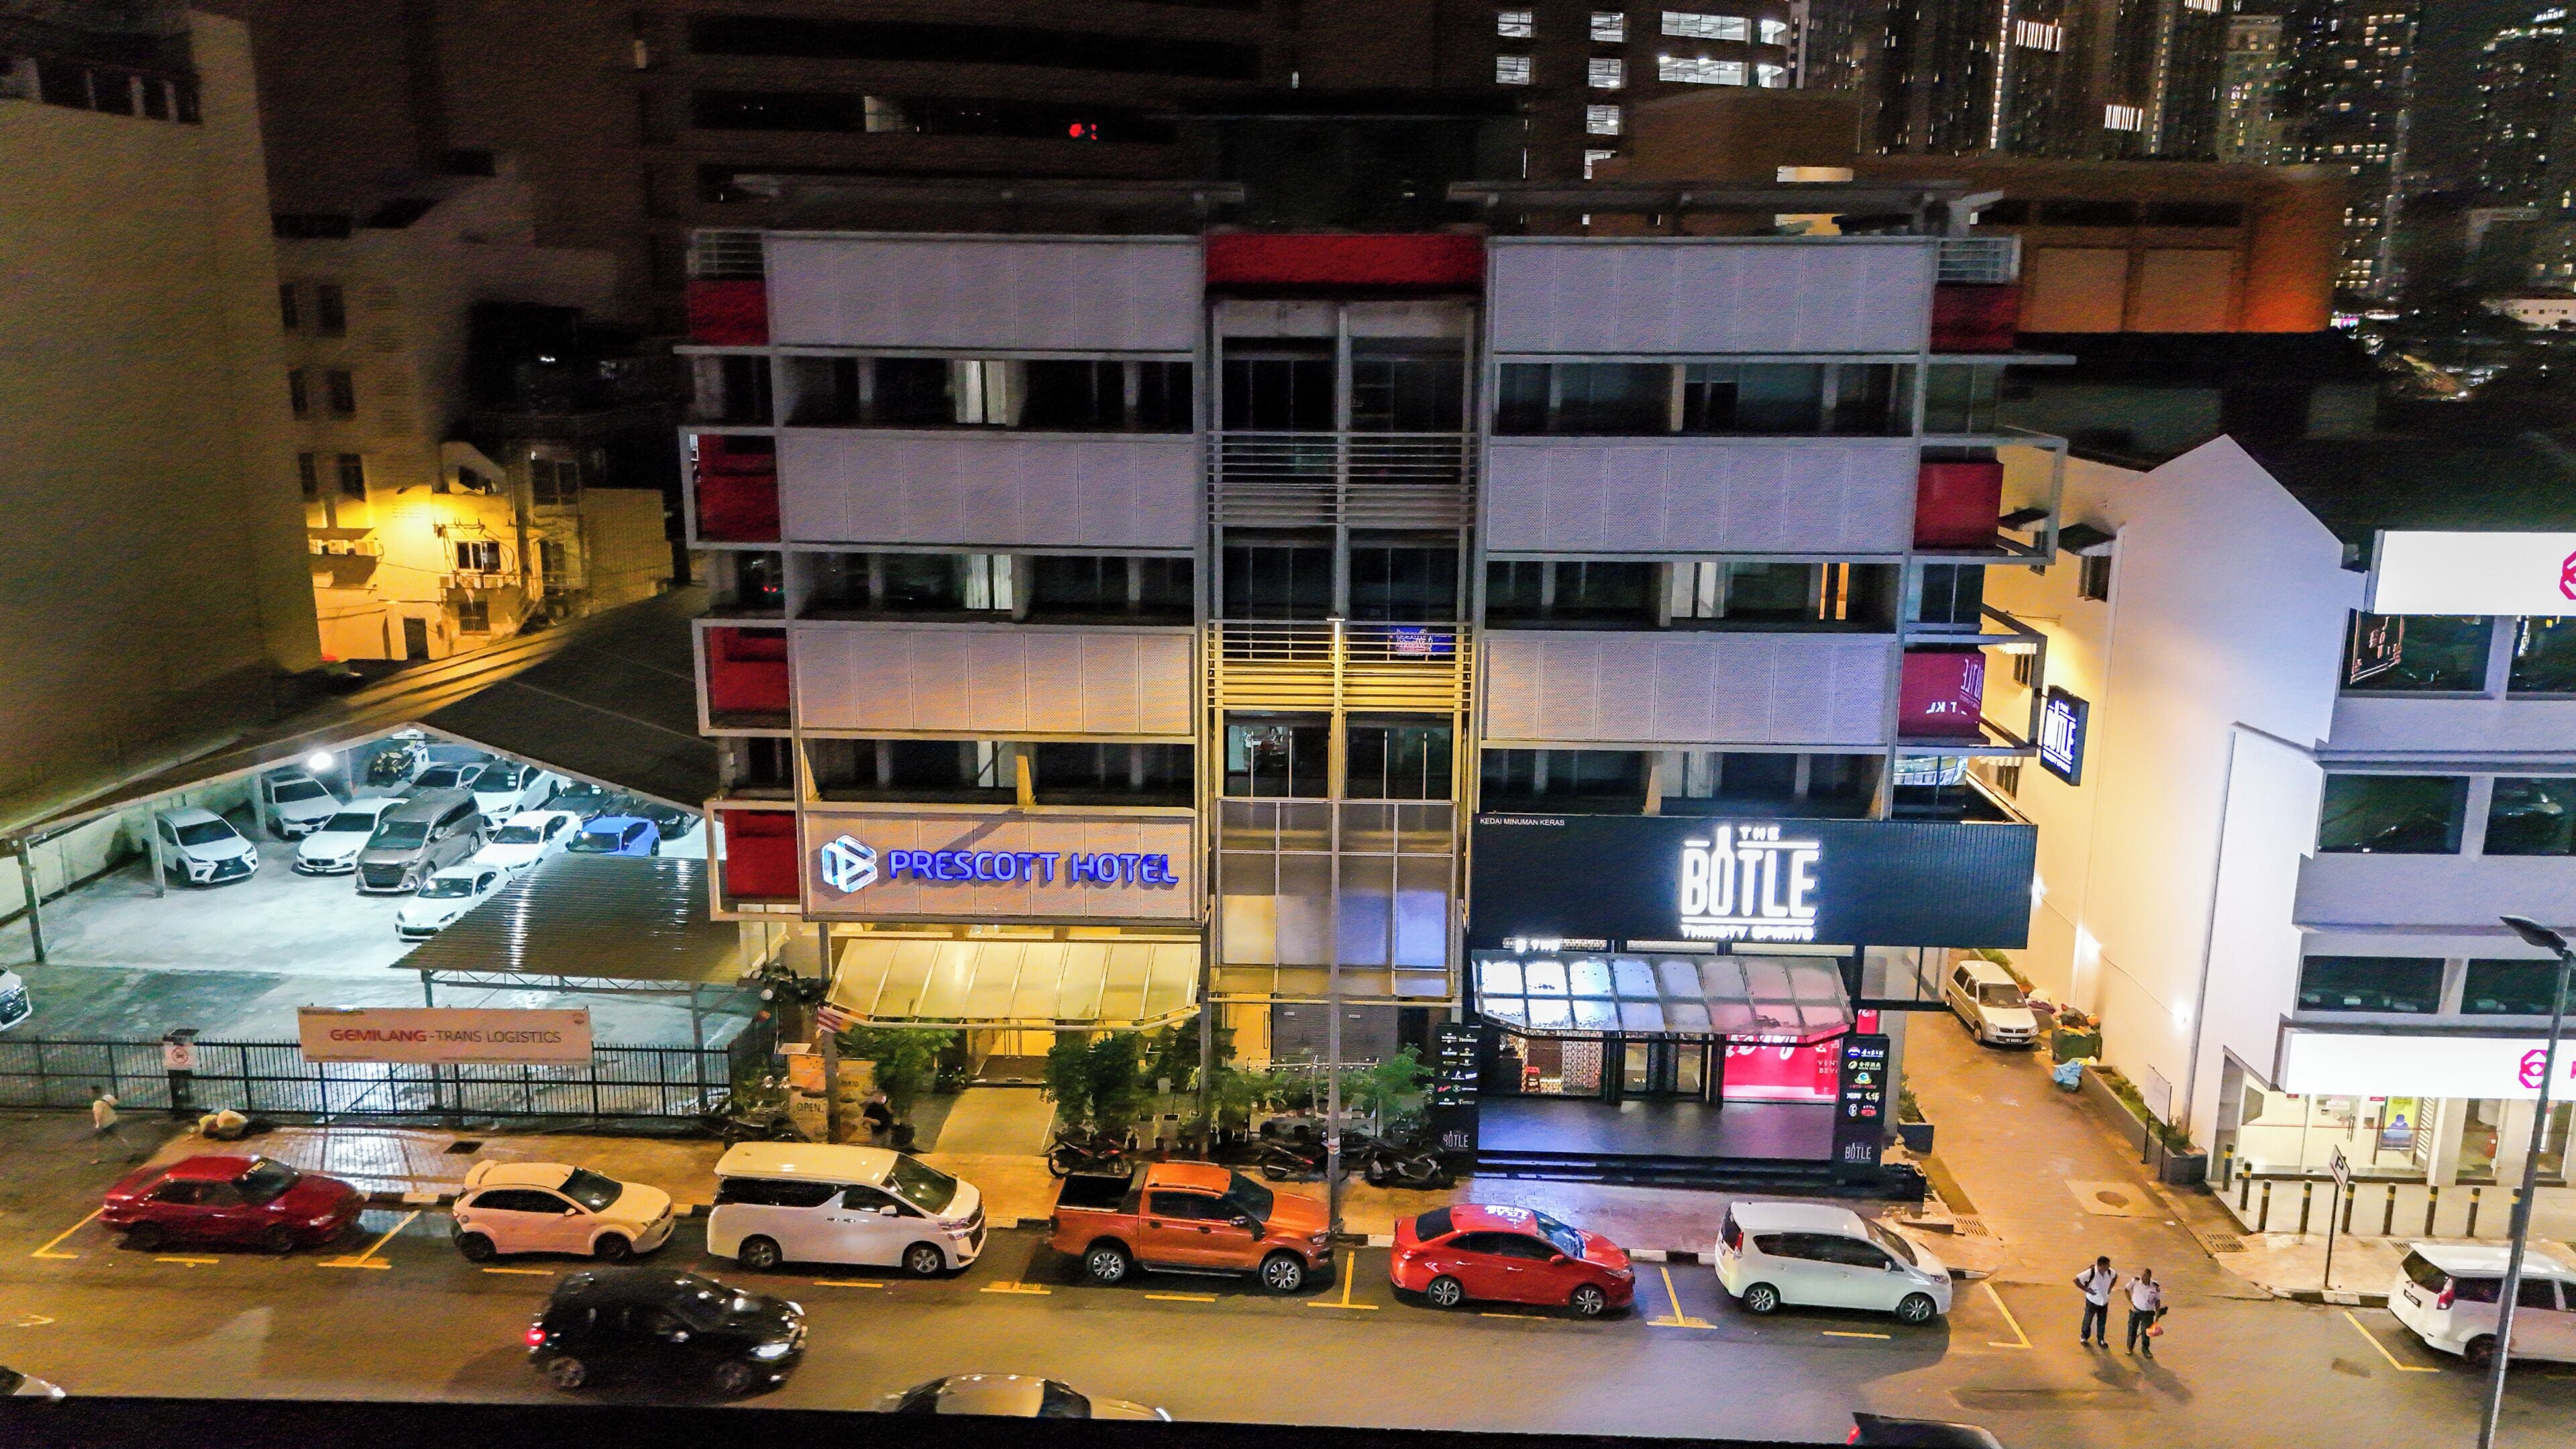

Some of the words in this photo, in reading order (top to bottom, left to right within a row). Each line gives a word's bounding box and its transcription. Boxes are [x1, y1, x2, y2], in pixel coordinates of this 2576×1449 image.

[1739, 826, 1780, 841] THE
[889, 850, 1060, 882] PRESCOTT
[1071, 853, 1179, 884] HOTEL
[1681, 826, 1820, 918] BOTLE
[330, 1029, 427, 1042] GEMILANG
[487, 1031, 562, 1043] LOGISTICS
[1845, 1142, 1872, 1160] BOTLE
